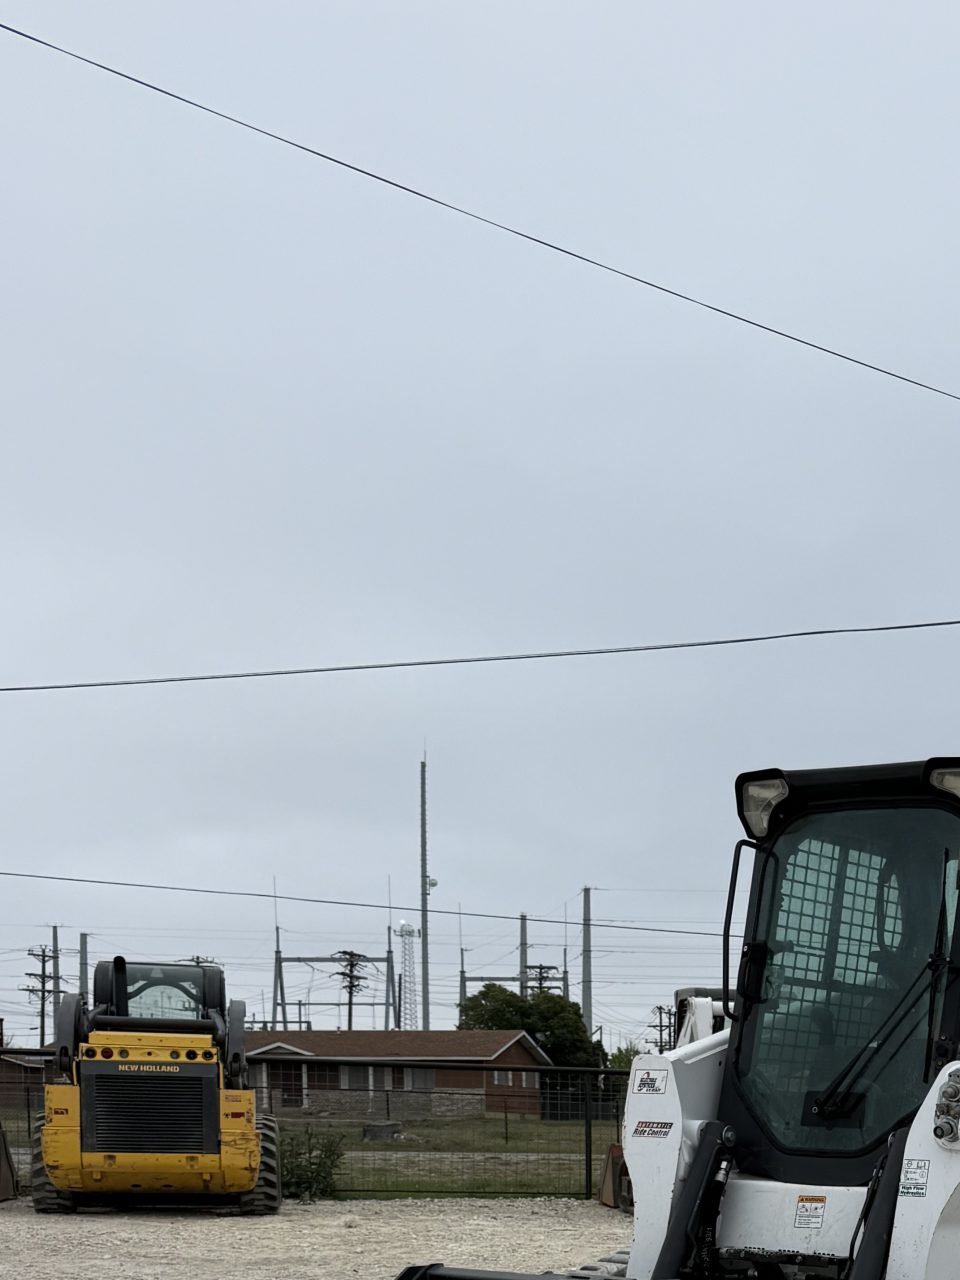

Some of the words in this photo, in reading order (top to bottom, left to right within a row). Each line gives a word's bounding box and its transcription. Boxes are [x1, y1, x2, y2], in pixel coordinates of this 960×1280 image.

[118, 1064, 138, 1072] NEW
[140, 1065, 180, 1073] HOLLAND
[637, 1121, 672, 1129] AUTOMATIC
[633, 1128, 647, 1136] Ride
[647, 1128, 670, 1137] Control
